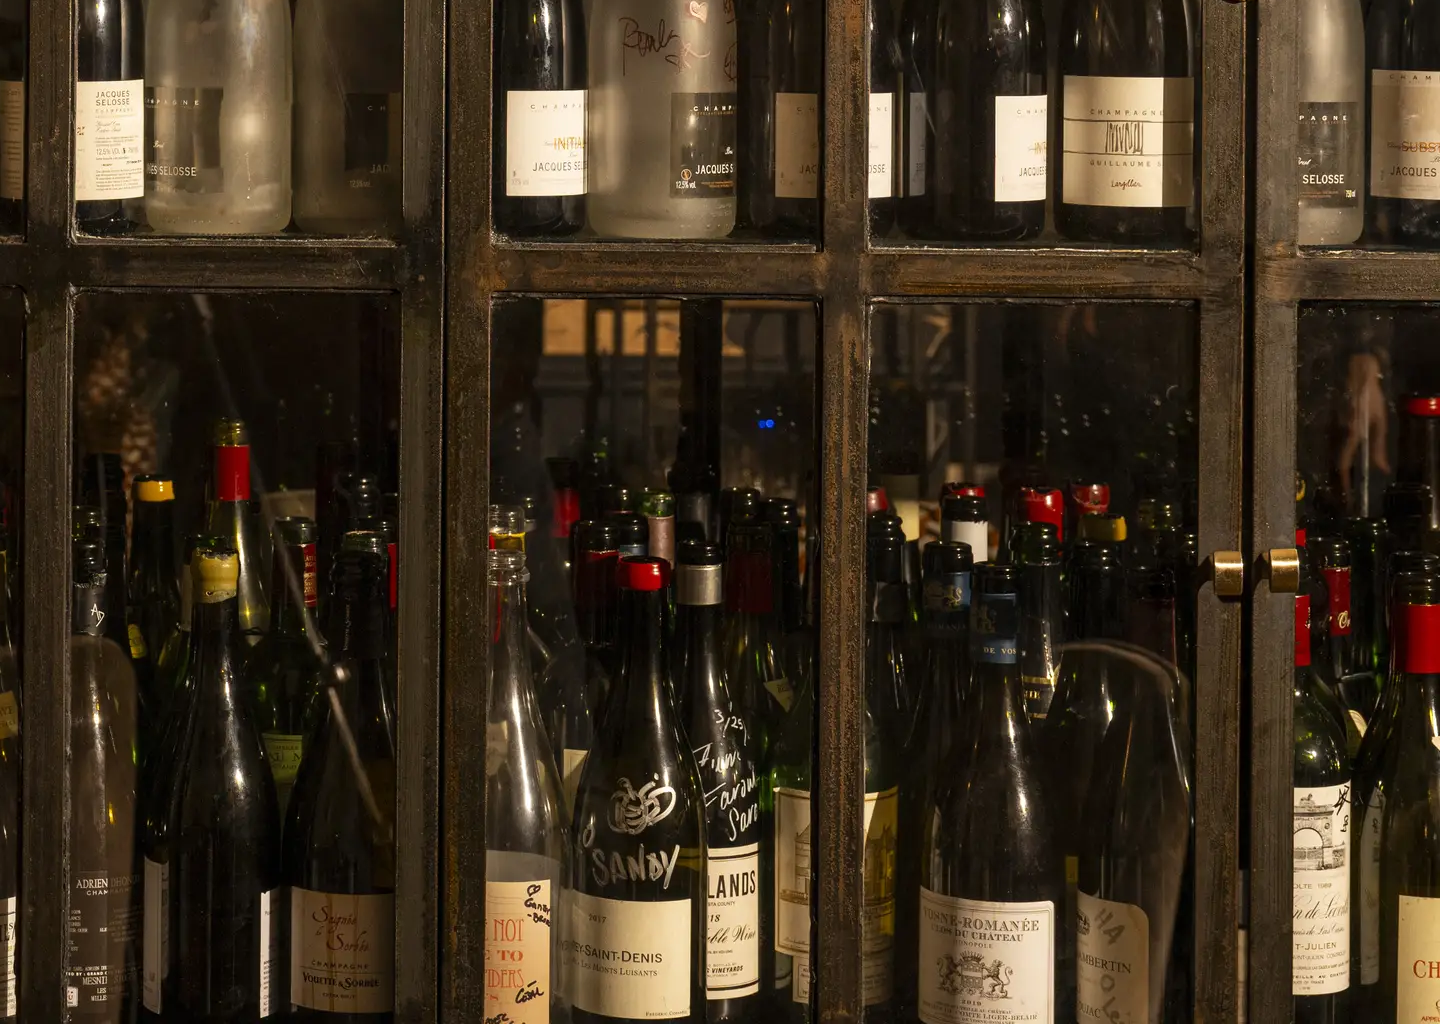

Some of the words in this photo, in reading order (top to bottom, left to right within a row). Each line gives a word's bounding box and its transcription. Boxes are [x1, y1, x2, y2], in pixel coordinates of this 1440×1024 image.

[95, 90, 130, 98] JACQUES
[95, 97, 130, 107] SELOSSE
[1089, 108, 1164, 116] CHAMPAGNE
[532, 161, 572, 172] JACQUES
[695, 163, 727, 175] JACQUES
[1089, 160, 1152, 168] GUILLAUME
[159, 164, 197, 177] SELOSSE
[1390, 166, 1437, 178] JACQUES
[1302, 174, 1345, 185] SELOSSE
[591, 843, 681, 890] SANDY
[76, 878, 108, 890] ADRIEN
[714, 900, 736, 908] COUNTY
[588, 913, 607, 924] 2017
[922, 906, 1040, 933] VOSNE-ROMANÉE
[492, 917, 525, 943] NOT
[955, 927, 969, 939] DU
[970, 929, 1024, 943] CHÂTEAU
[496, 949, 524, 963] TO
[311, 960, 371, 971] CHAMPAGNE
[983, 1012, 1038, 1021] LIGER-BELAIR
